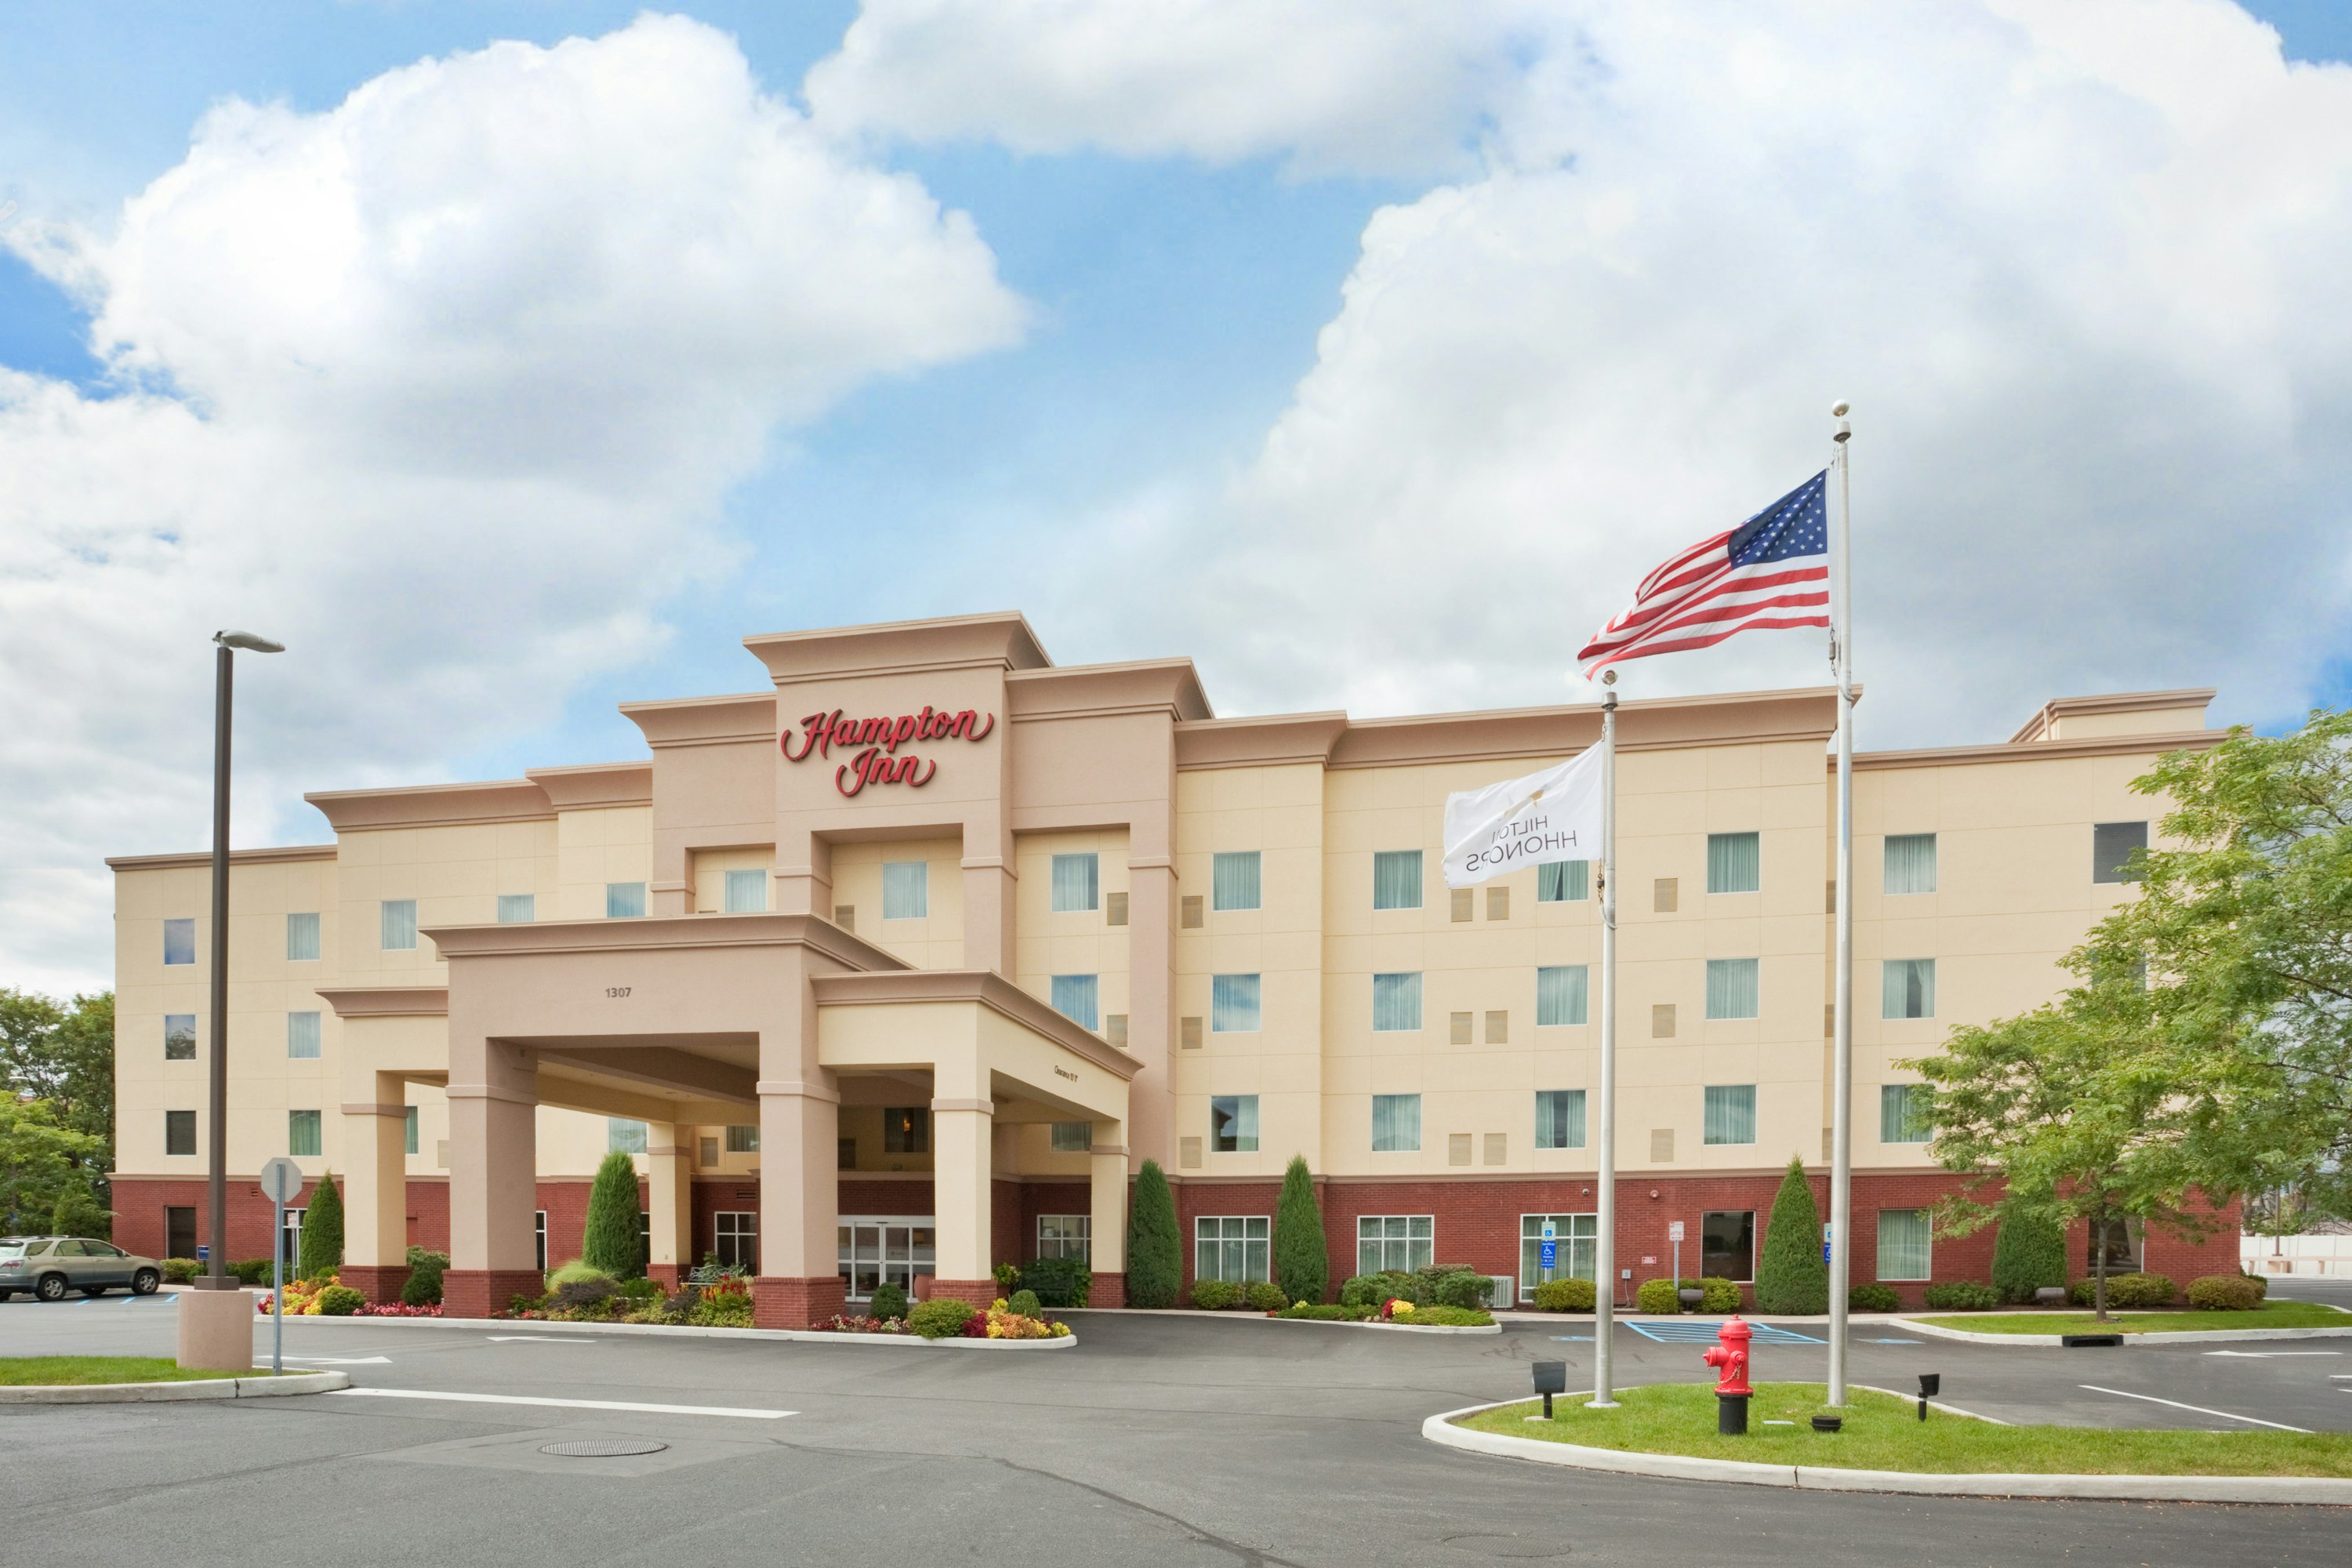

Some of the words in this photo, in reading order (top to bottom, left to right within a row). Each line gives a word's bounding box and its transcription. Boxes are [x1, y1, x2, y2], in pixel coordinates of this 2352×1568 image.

[780, 706, 994, 762] Hampton
[835, 747, 936, 797] Inn
[605, 987, 632, 998] 1307
